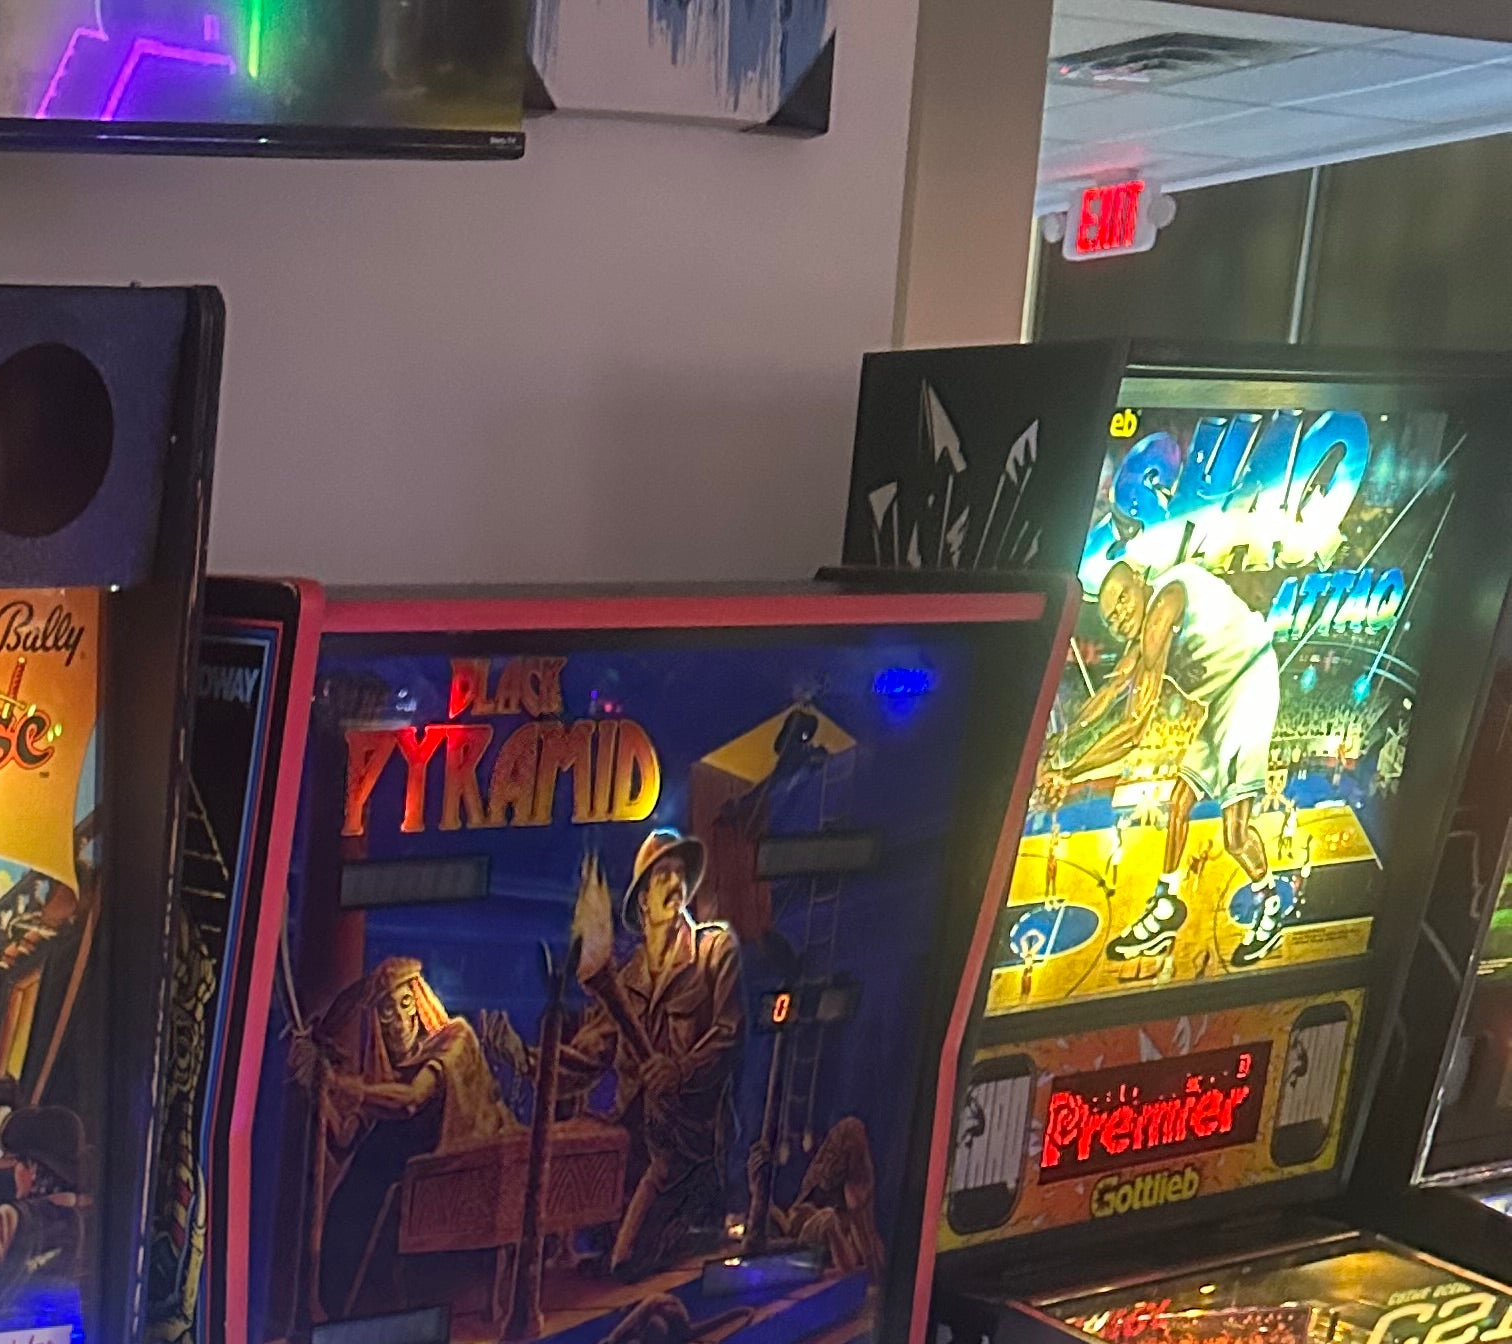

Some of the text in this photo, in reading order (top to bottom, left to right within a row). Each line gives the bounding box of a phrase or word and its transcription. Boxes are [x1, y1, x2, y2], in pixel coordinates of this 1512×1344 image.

[1076, 180, 1145, 254] EXIT
[447, 655, 568, 719] BLACK
[340, 718, 662, 838] PYRAMID
[1040, 1086, 1251, 1168] Premier
[1091, 1165, 1201, 1218] Gottlieb
